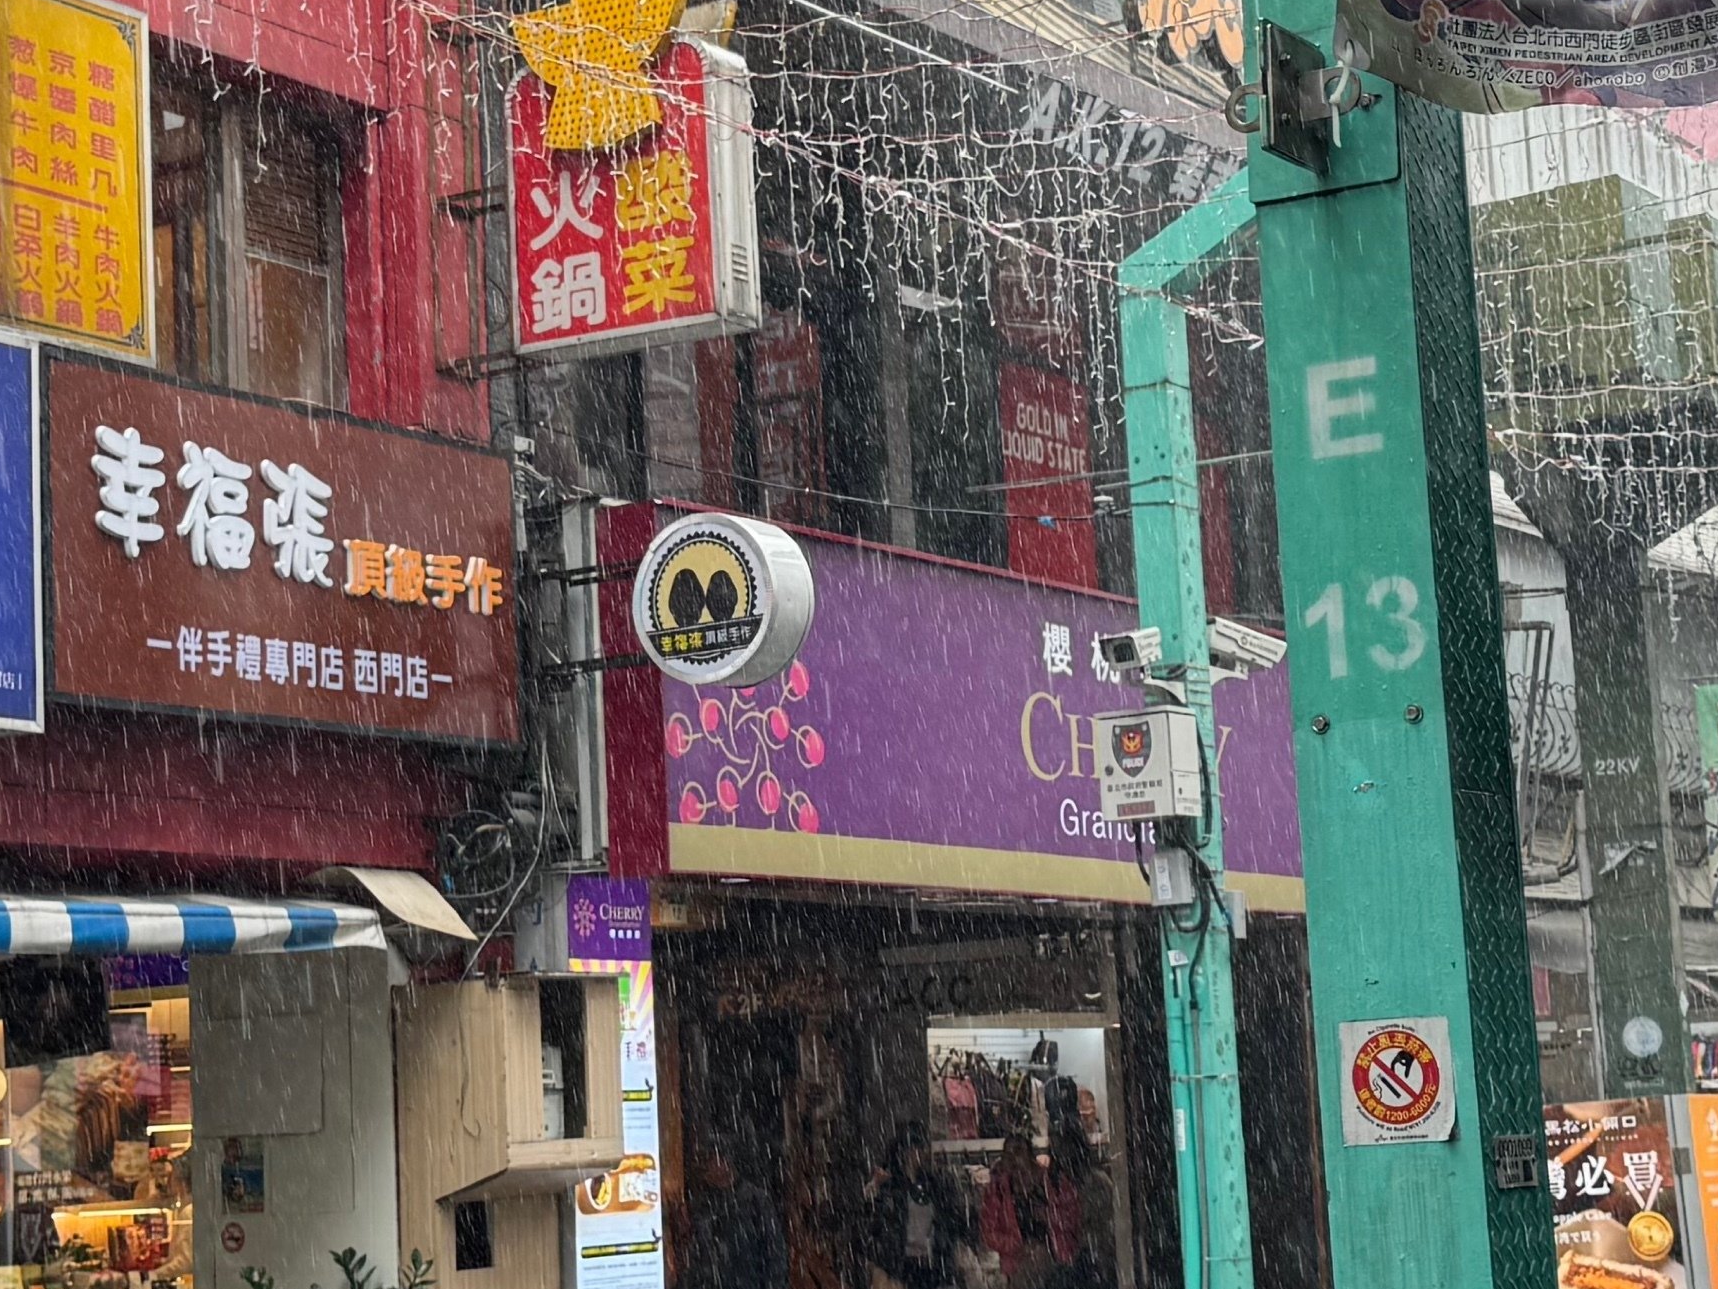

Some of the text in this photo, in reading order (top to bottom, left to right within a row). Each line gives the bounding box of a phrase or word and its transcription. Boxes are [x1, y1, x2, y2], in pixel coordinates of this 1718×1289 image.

[1514, 48, 1582, 62] PEDESTRIAN
[1585, 50, 1617, 62] AREA
[1619, 40, 1700, 61] DEVELOPMENT
[529, 169, 607, 335] 火鍋
[1016, 402, 1069, 441] GOLD IN
[1306, 355, 1384, 460] E
[1002, 430, 1086, 474] LIQUID STATE
[1304, 575, 1428, 681] 13
[1595, 756, 1641, 777] 22KV
[600, 903, 644, 921] CHERRY
